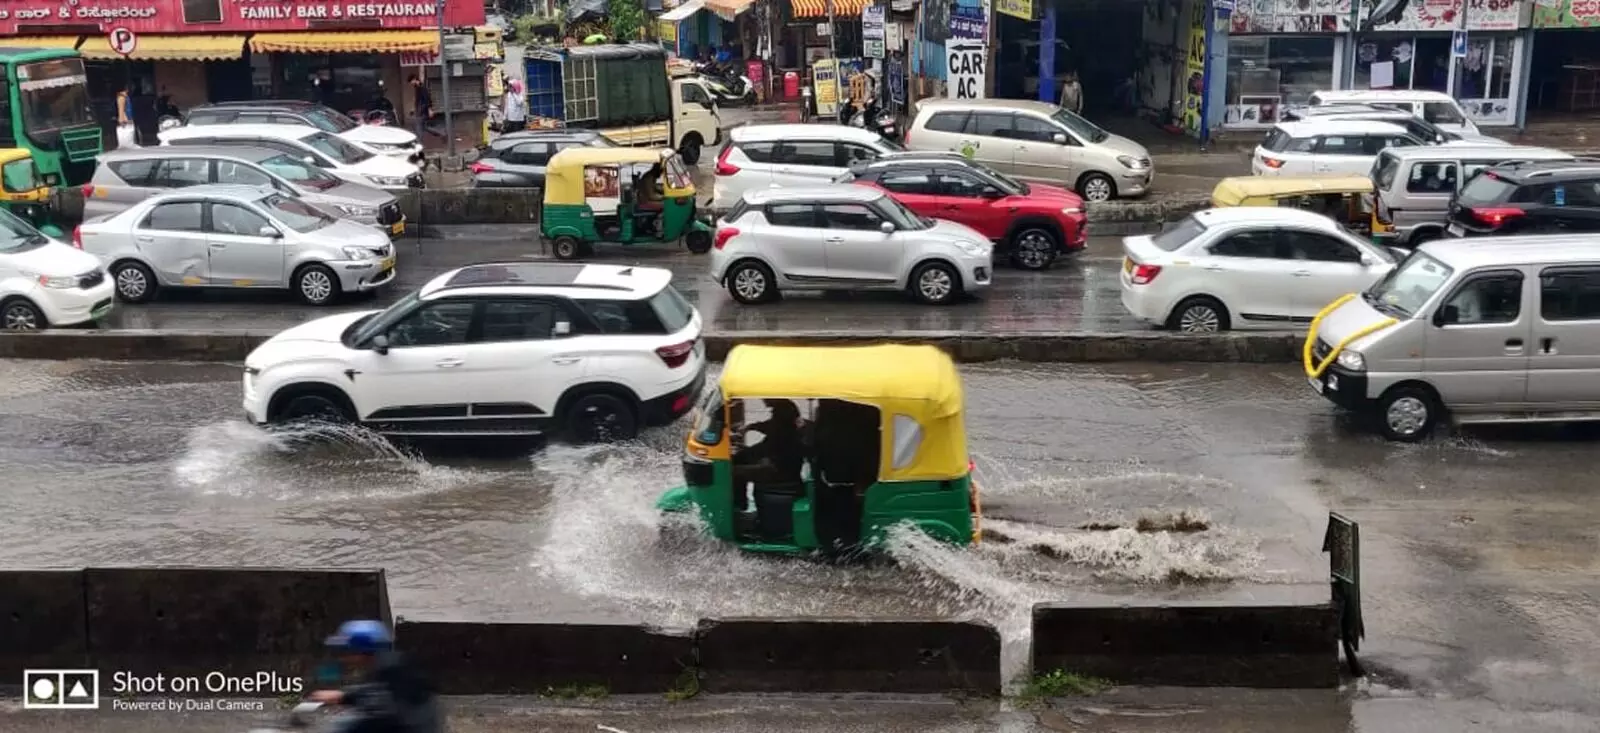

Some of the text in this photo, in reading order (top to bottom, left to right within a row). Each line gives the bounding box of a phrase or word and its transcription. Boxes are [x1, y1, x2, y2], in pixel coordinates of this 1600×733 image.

[58, 6, 70, 18] &
[240, 6, 292, 18] FAMILY
[297, 5, 327, 18] BAR
[332, 4, 342, 16] &
[116, 31, 131, 50] P
[949, 53, 983, 74] CAR
[957, 77, 977, 99] AC
